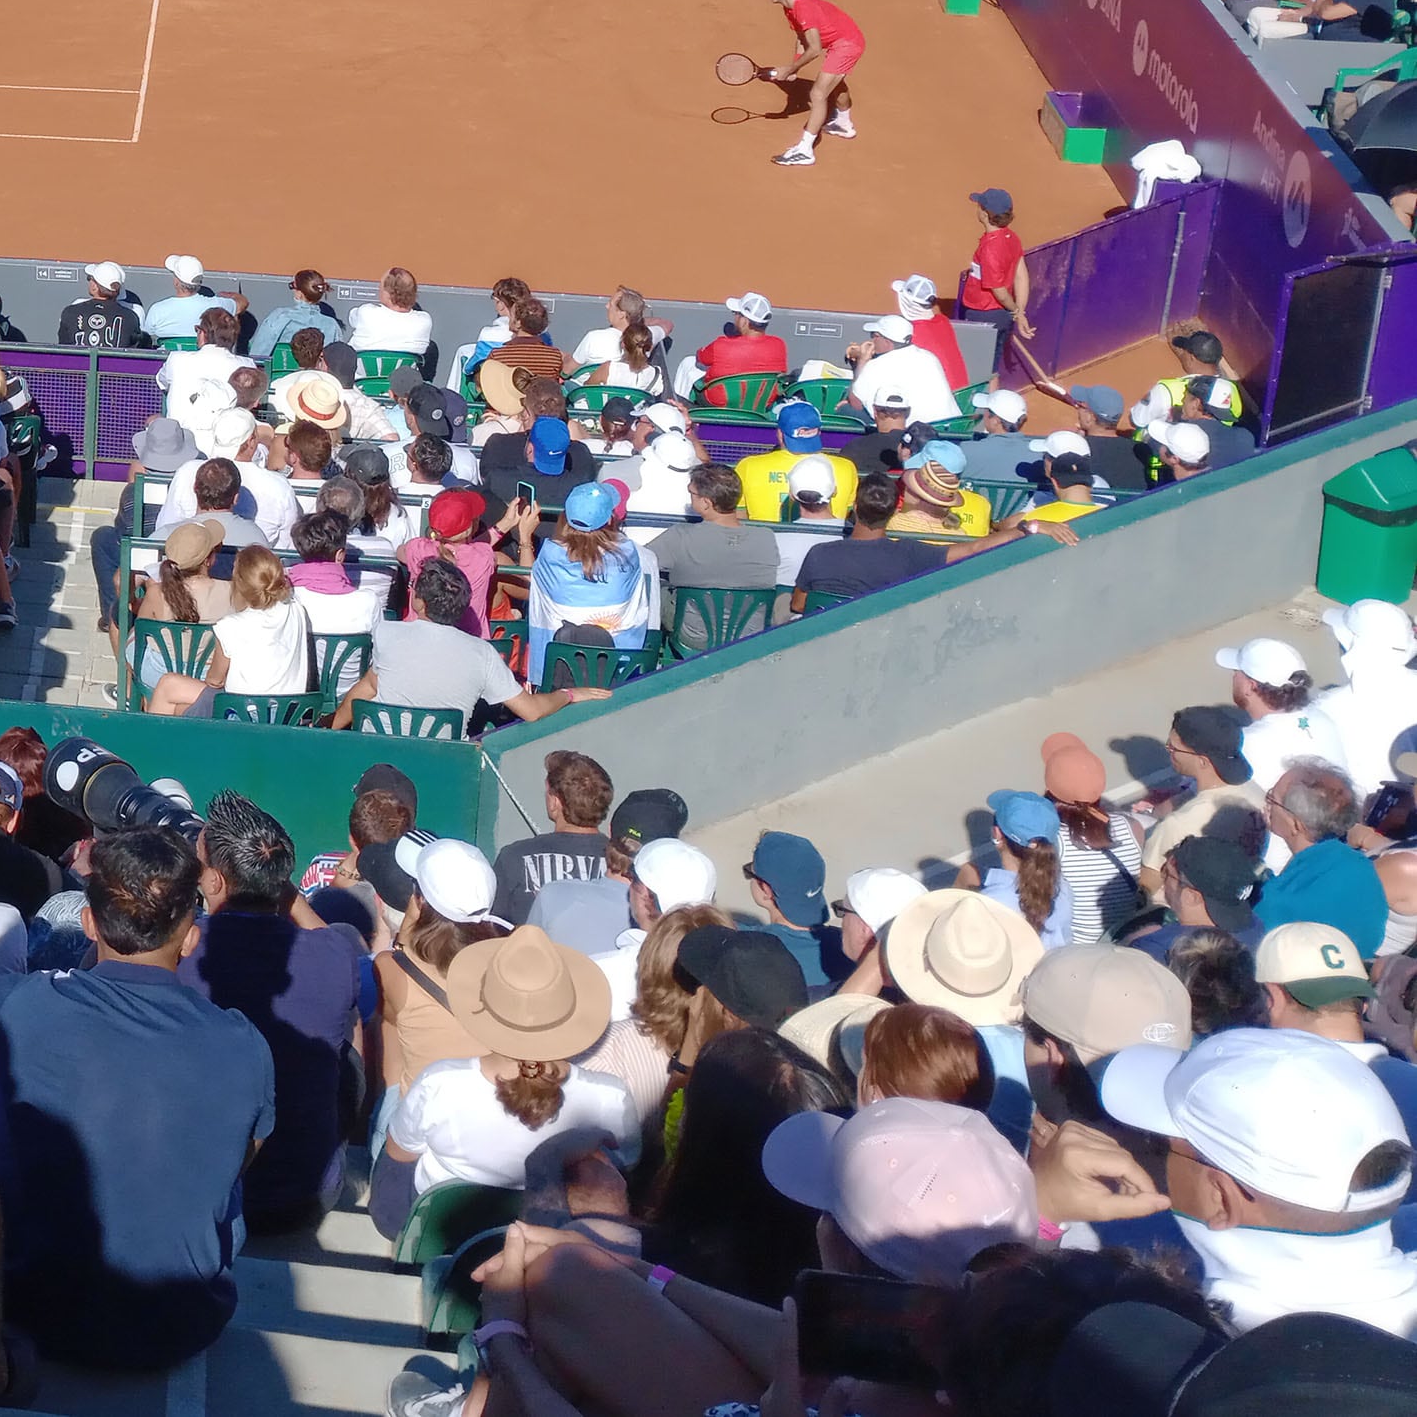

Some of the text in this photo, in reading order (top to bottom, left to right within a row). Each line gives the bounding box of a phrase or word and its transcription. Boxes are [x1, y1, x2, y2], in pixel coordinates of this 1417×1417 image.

[1148, 47, 1199, 135] motorola
[1251, 110, 1286, 171] Andina
[962, 514, 974, 524] JR
[1320, 944, 1346, 970] C
